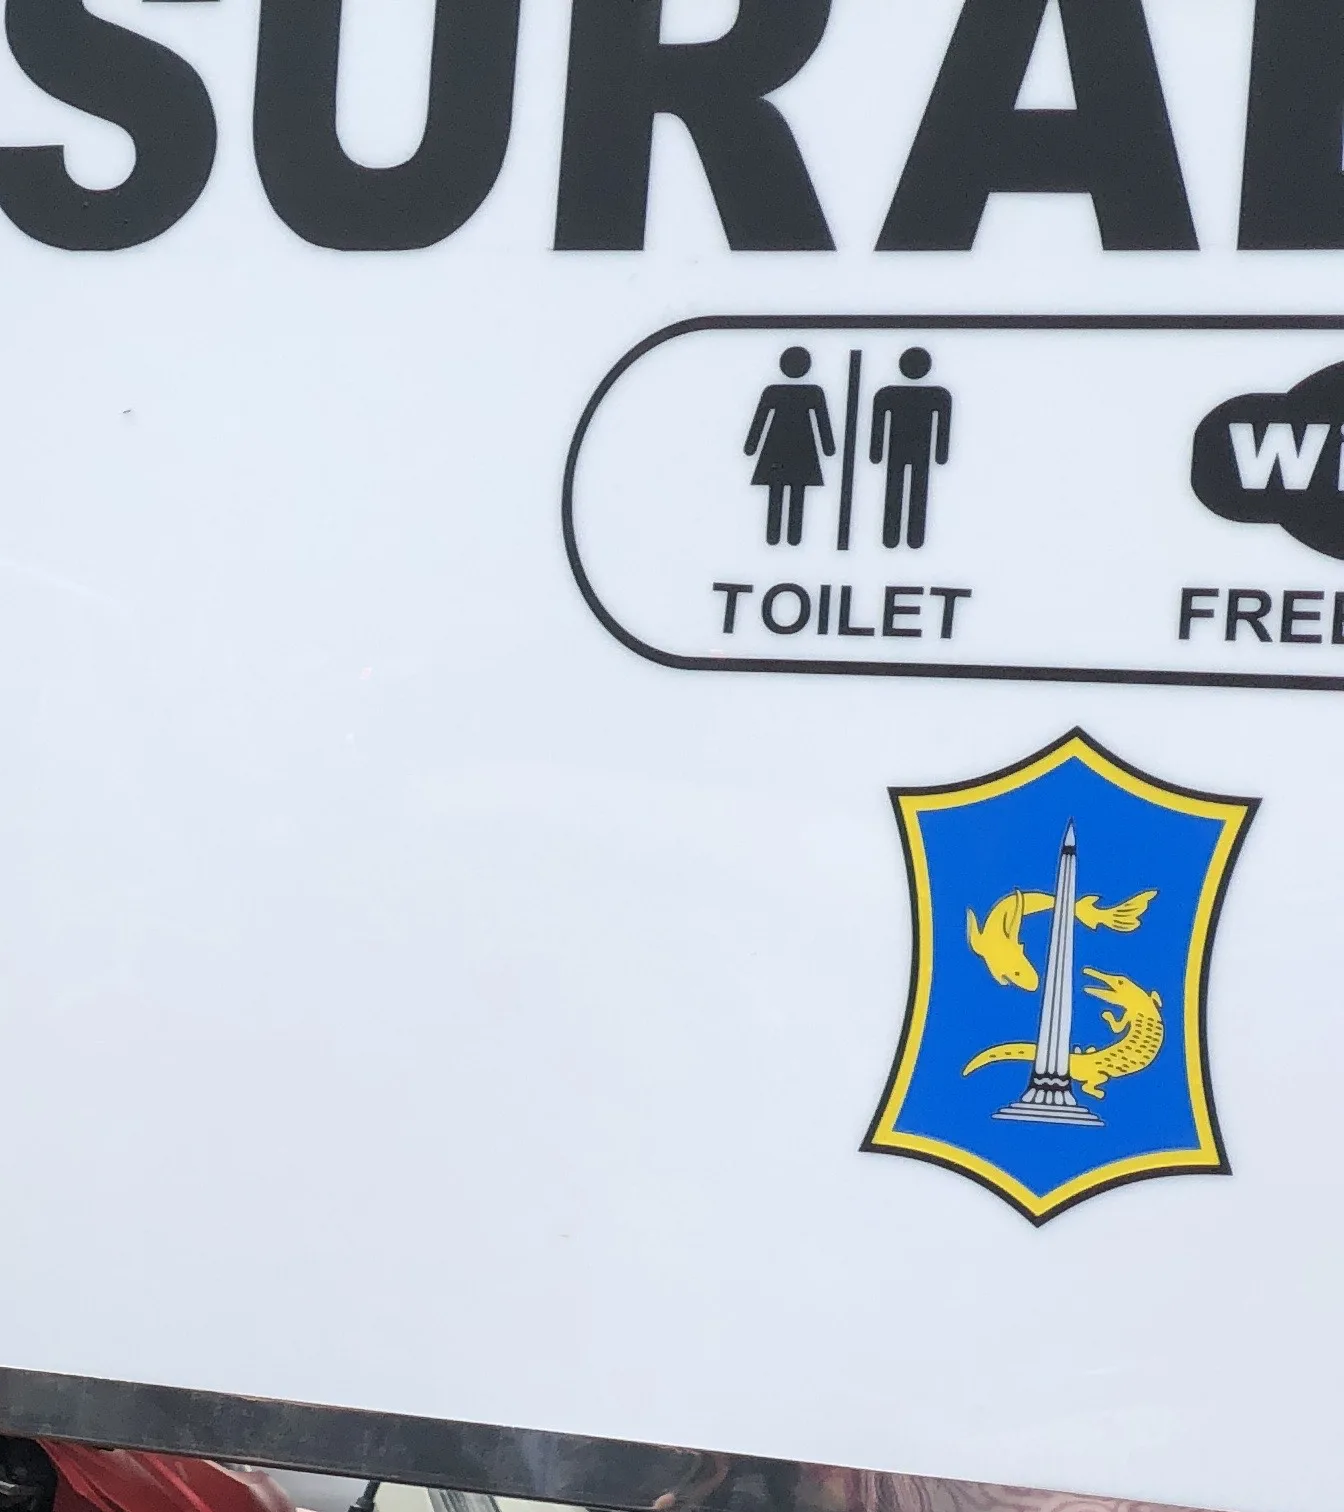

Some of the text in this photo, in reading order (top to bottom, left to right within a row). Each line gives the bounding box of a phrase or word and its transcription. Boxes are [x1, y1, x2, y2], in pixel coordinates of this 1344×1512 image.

[1229, 421, 1344, 491] W
[712, 582, 973, 639] TOILET
[1178, 587, 1344, 644] FRE
